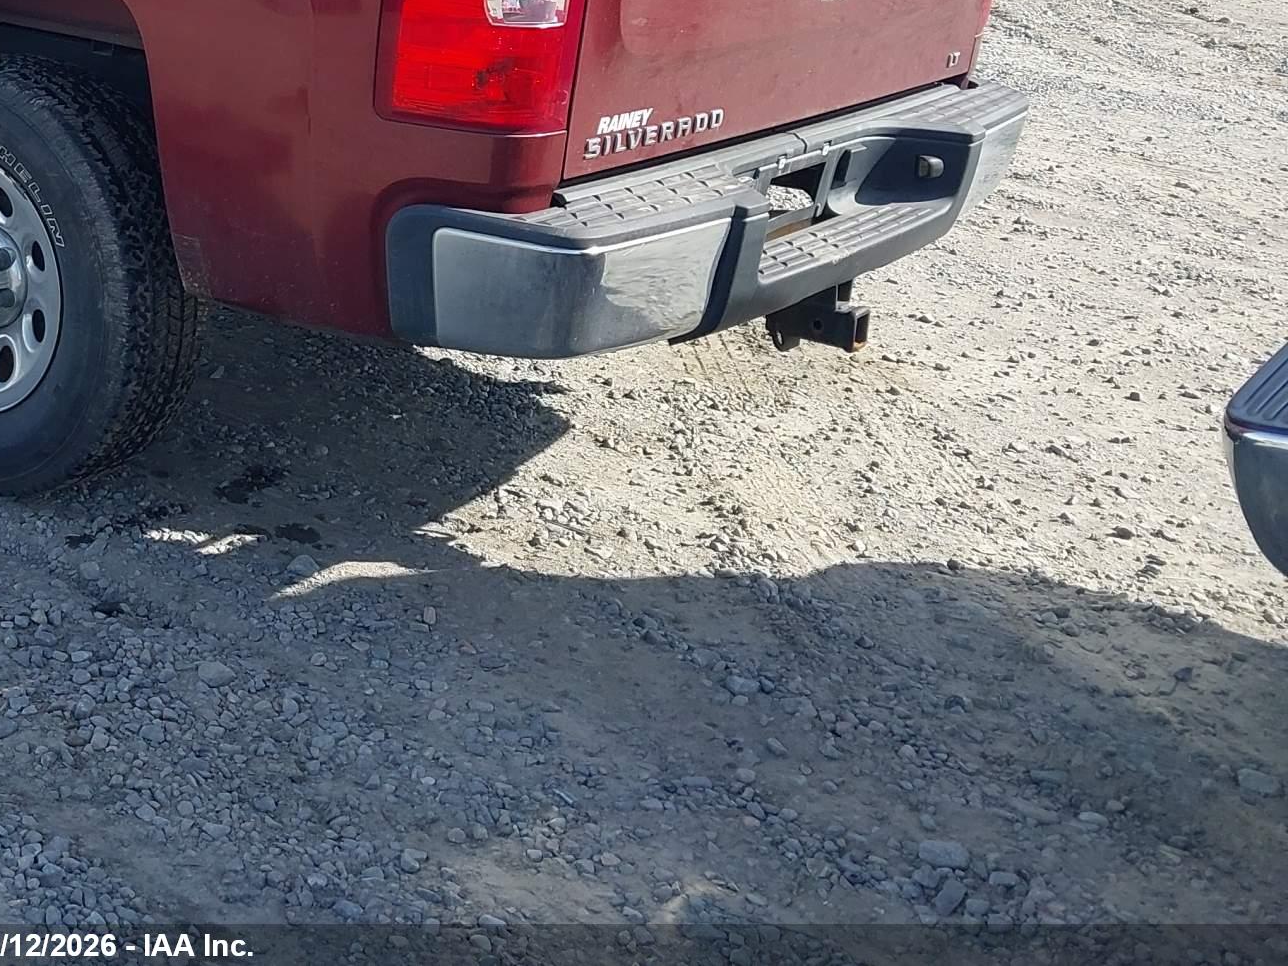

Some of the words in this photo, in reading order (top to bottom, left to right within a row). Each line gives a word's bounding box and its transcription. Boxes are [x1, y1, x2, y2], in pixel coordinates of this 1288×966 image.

[946, 51, 961, 68] LT
[583, 108, 724, 160] SILVERADO
[597, 107, 654, 135] RAINEY
